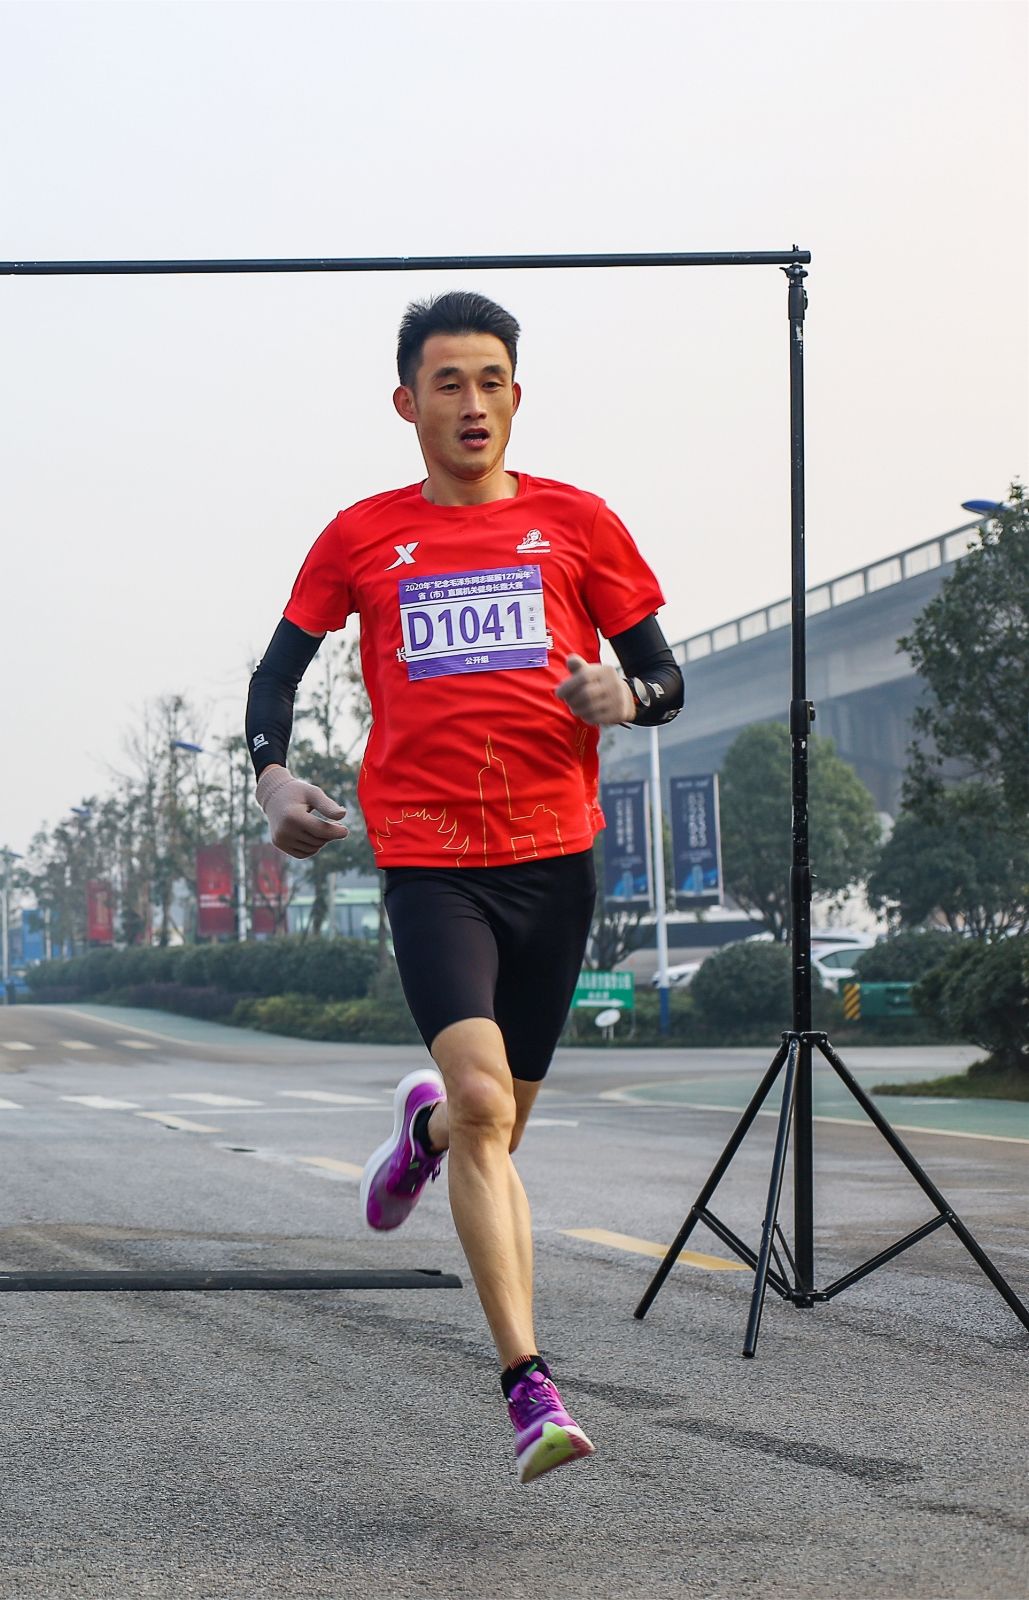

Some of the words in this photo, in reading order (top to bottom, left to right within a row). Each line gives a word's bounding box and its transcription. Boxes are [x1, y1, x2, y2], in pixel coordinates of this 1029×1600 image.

[407, 601, 523, 651] D1041
[465, 655, 489, 665] 公开组
